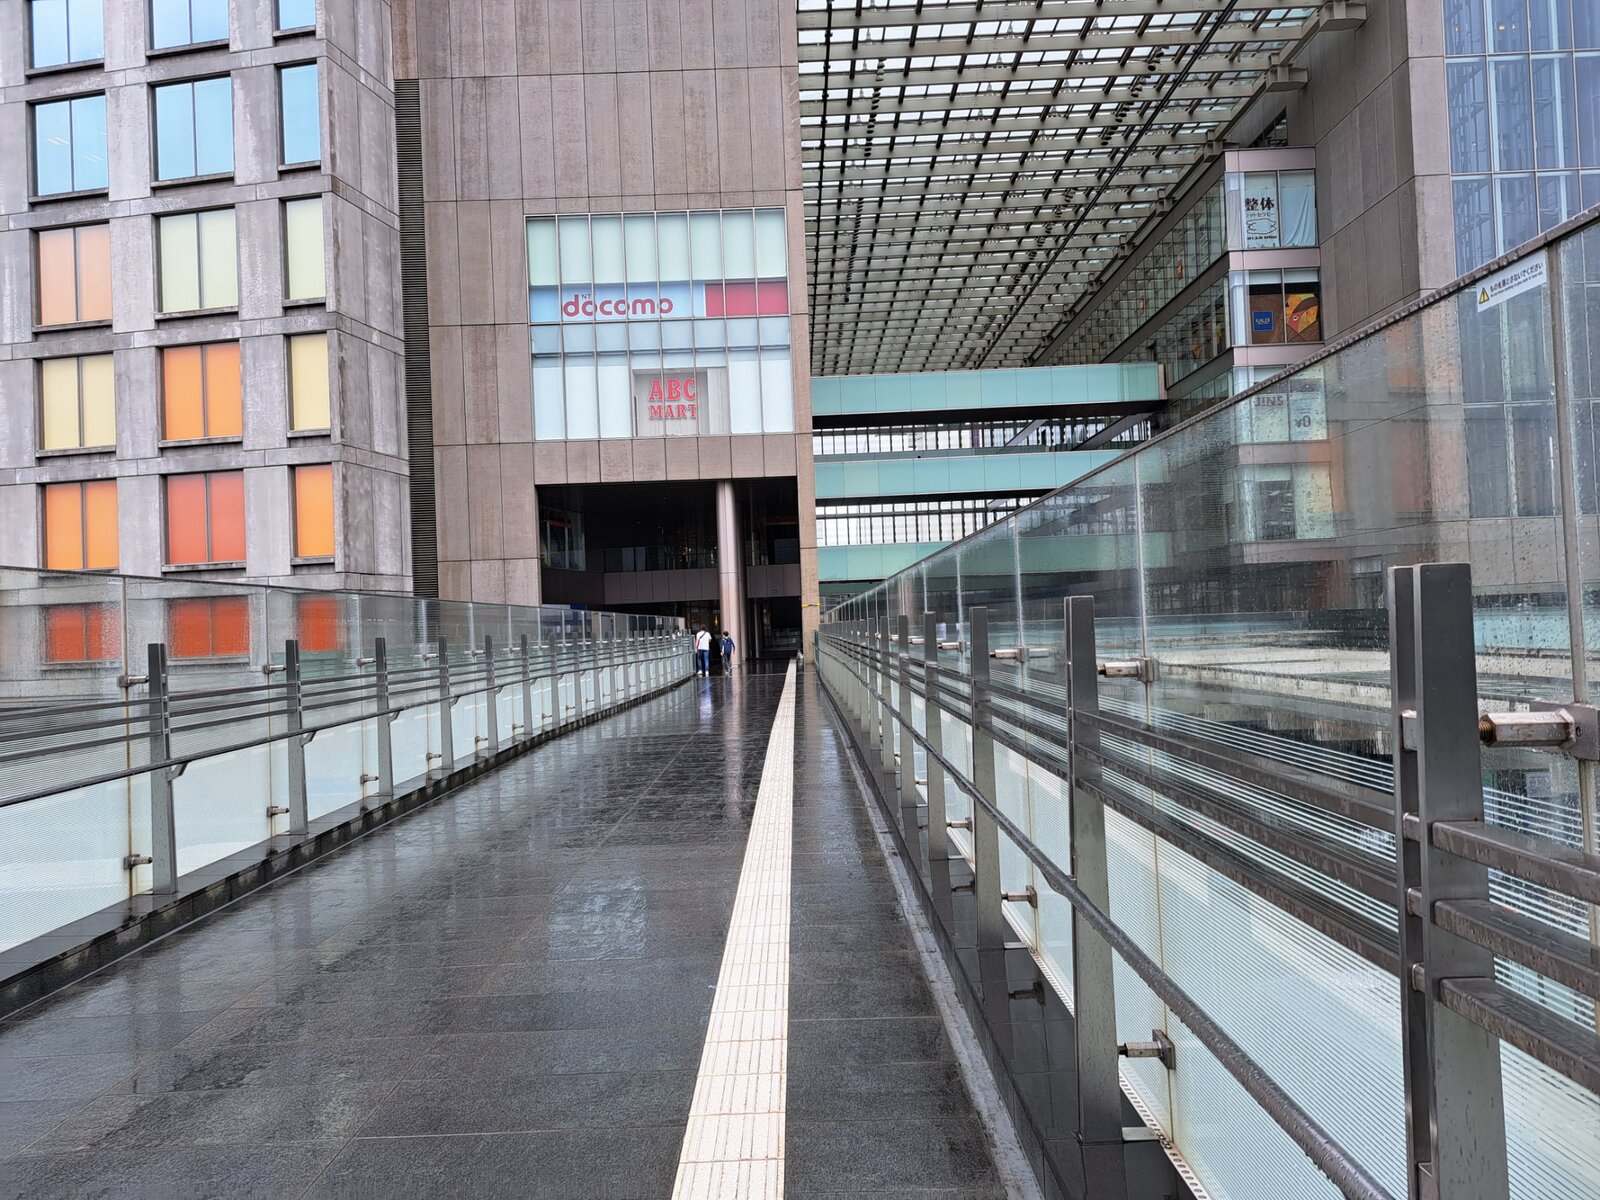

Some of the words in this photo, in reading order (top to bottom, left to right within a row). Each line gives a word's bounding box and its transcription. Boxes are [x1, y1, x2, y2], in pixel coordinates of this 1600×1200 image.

[1245, 197, 1275, 212] 整体
[563, 294, 674, 317] docomo
[648, 378, 697, 401] ABC
[648, 403, 697, 419] MART
